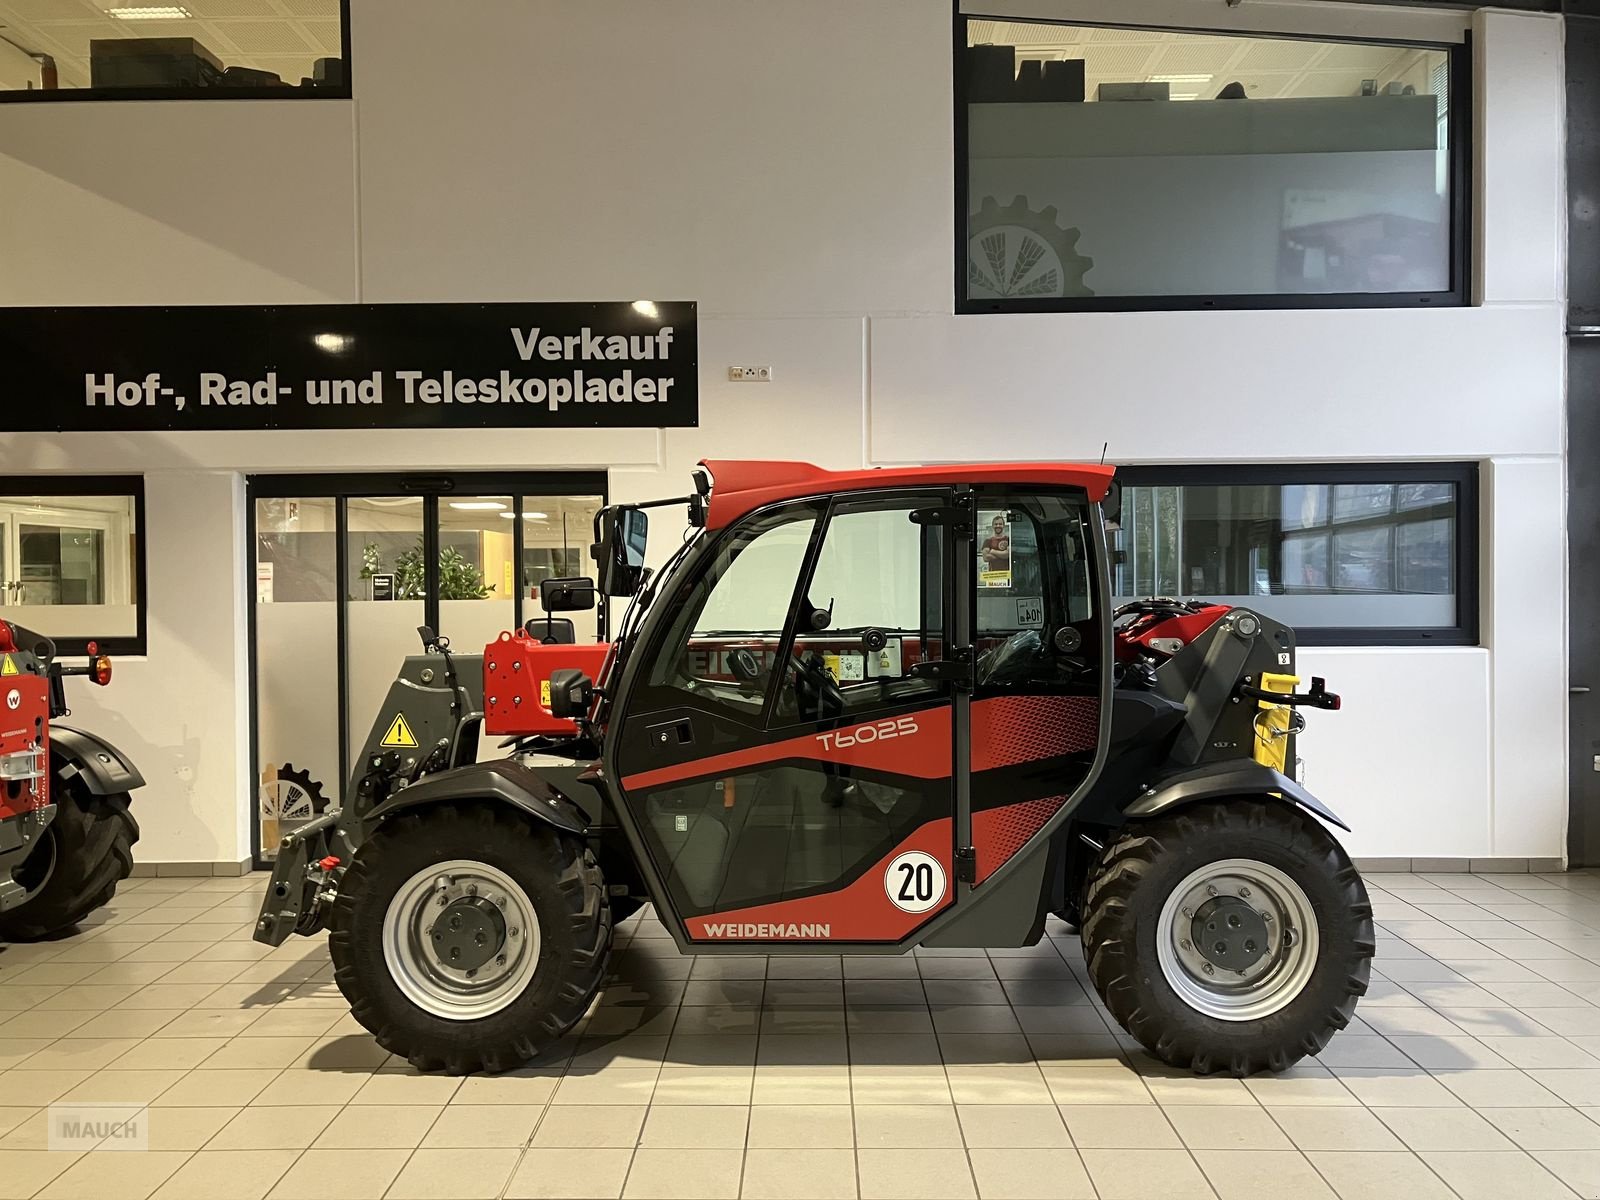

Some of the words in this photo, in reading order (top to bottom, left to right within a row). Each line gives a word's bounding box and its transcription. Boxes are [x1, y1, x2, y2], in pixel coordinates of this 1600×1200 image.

[511, 327, 674, 361] Verkauf
[85, 373, 186, 411] Hof-,
[200, 372, 292, 405] Rad-
[306, 371, 383, 404] und
[396, 369, 674, 411] Teleskoplader
[816, 717, 919, 751] T6025
[897, 863, 933, 901] 20
[703, 923, 831, 938] WEIDEMANN
